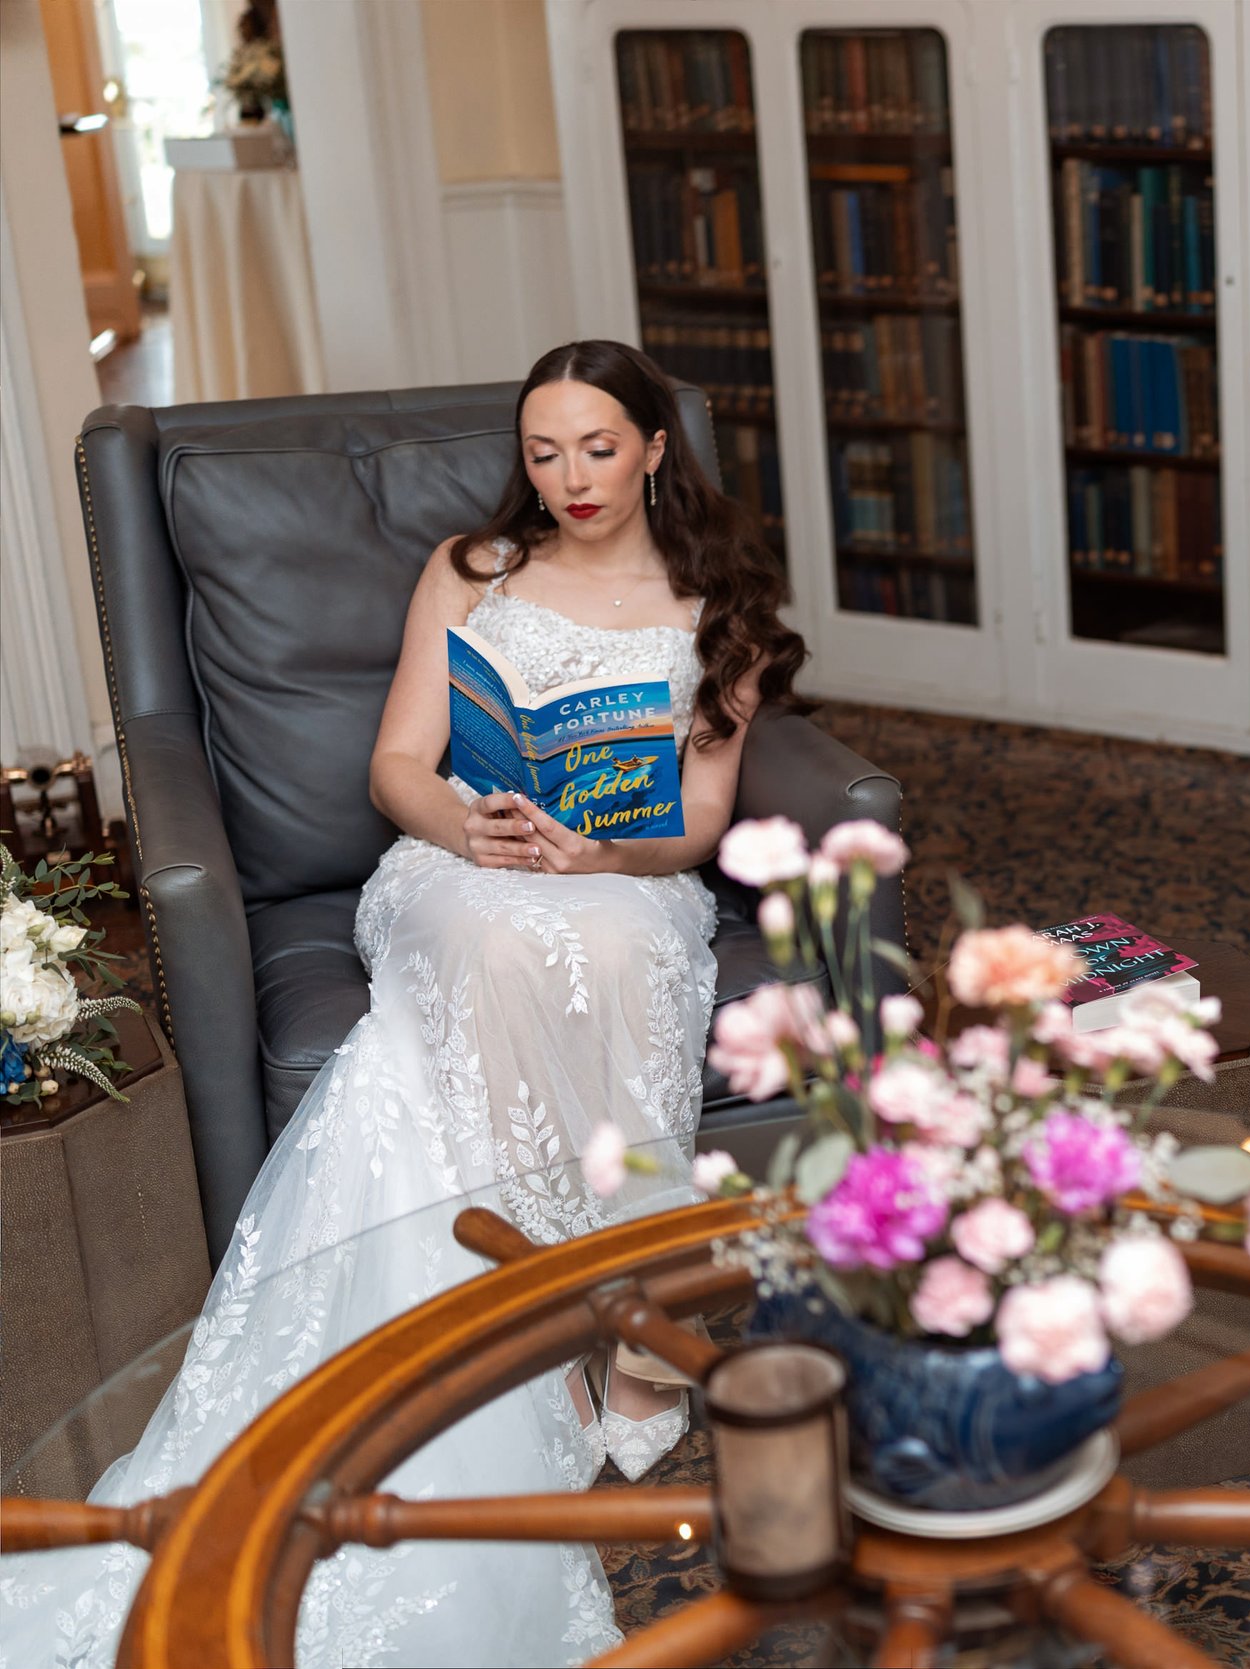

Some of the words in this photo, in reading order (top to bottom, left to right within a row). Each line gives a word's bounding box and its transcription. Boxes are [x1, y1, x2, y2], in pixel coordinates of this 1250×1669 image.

[559, 691, 644, 716] CARLEY
[553, 707, 656, 735] FORTUNE
[564, 742, 614, 773] One
[526, 763, 542, 794] Summer
[559, 770, 654, 813] Golden
[576, 801, 677, 836] Summer
[1032, 925, 1082, 942] ARAH
[1086, 922, 1100, 930] J.
[1070, 937, 1130, 959] OWN
[1085, 954, 1108, 966] OF
[1059, 948, 1165, 987] MIDNIGHT
